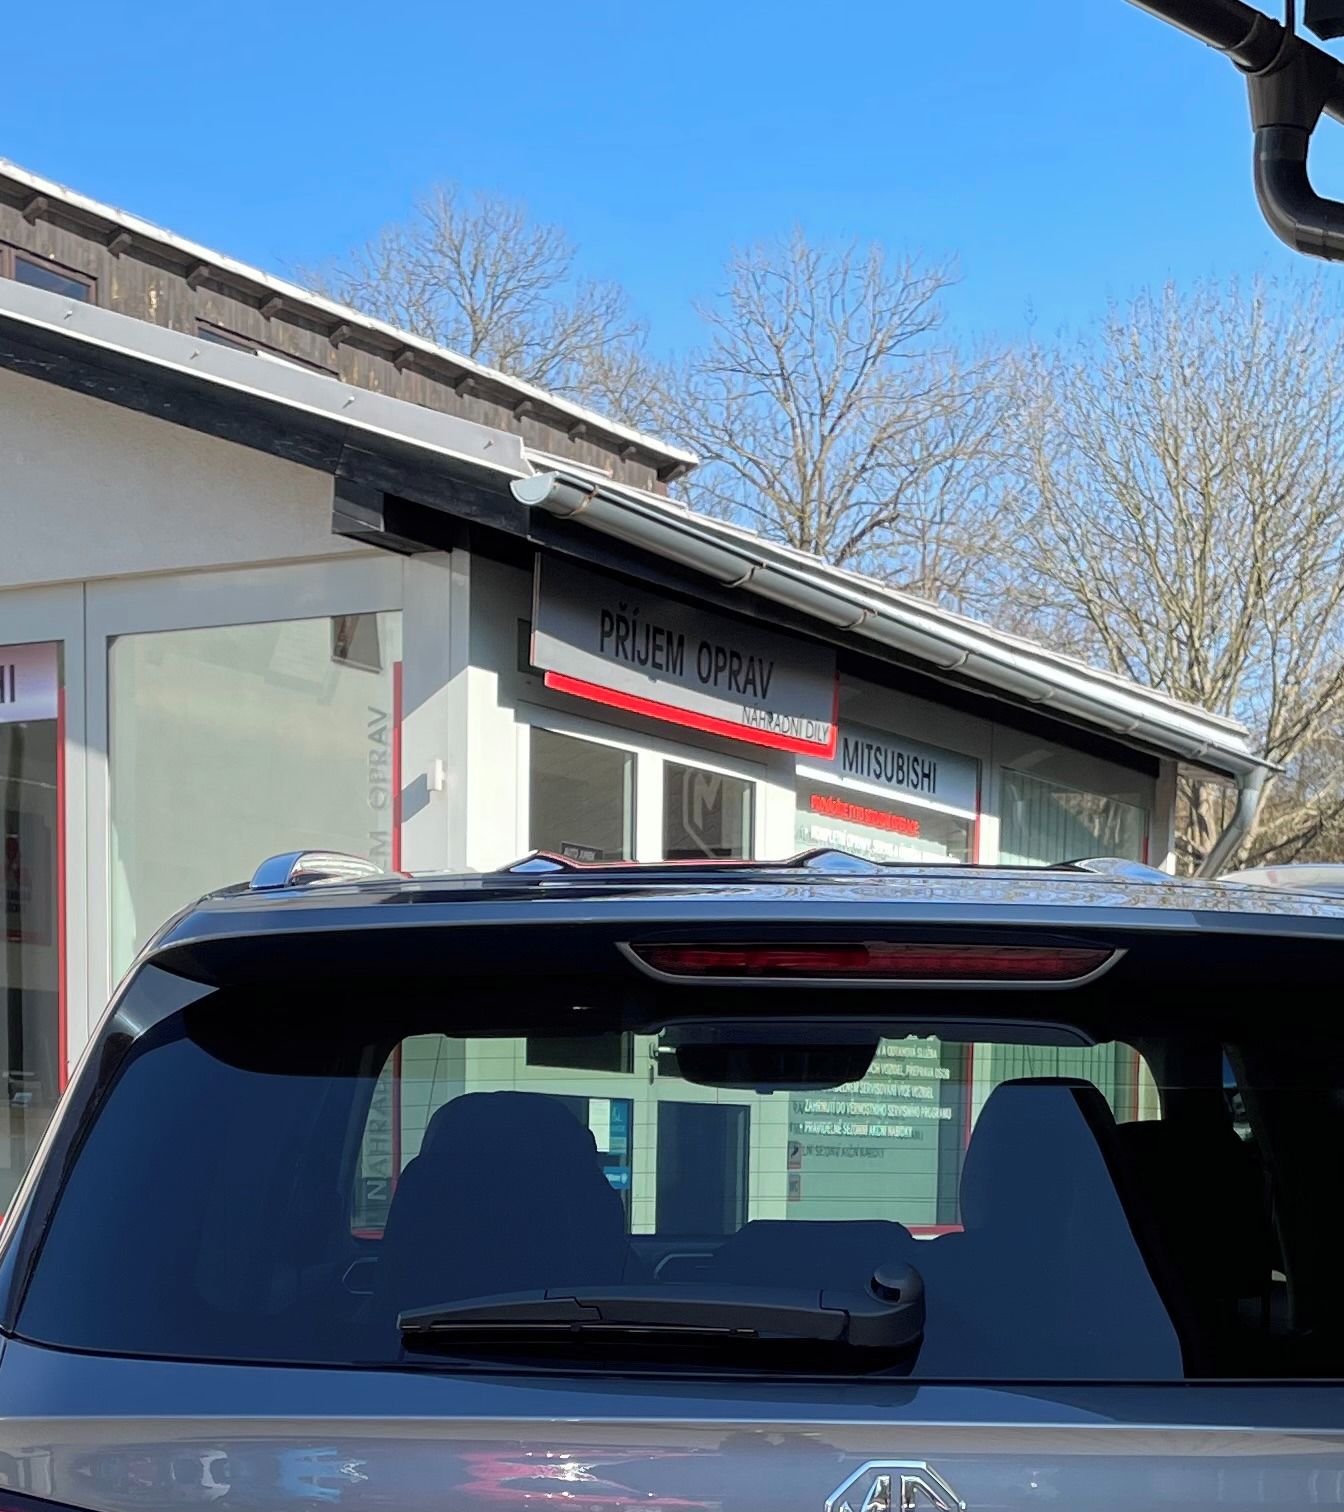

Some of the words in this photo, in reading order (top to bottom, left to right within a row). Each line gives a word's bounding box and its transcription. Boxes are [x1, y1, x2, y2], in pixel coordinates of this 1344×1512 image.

[600, 602, 685, 677] PŘÍJEM
[696, 641, 774, 700] OPRAV
[742, 704, 803, 738] NÁHRADNÍ
[842, 737, 937, 794] MITSUBISHI
